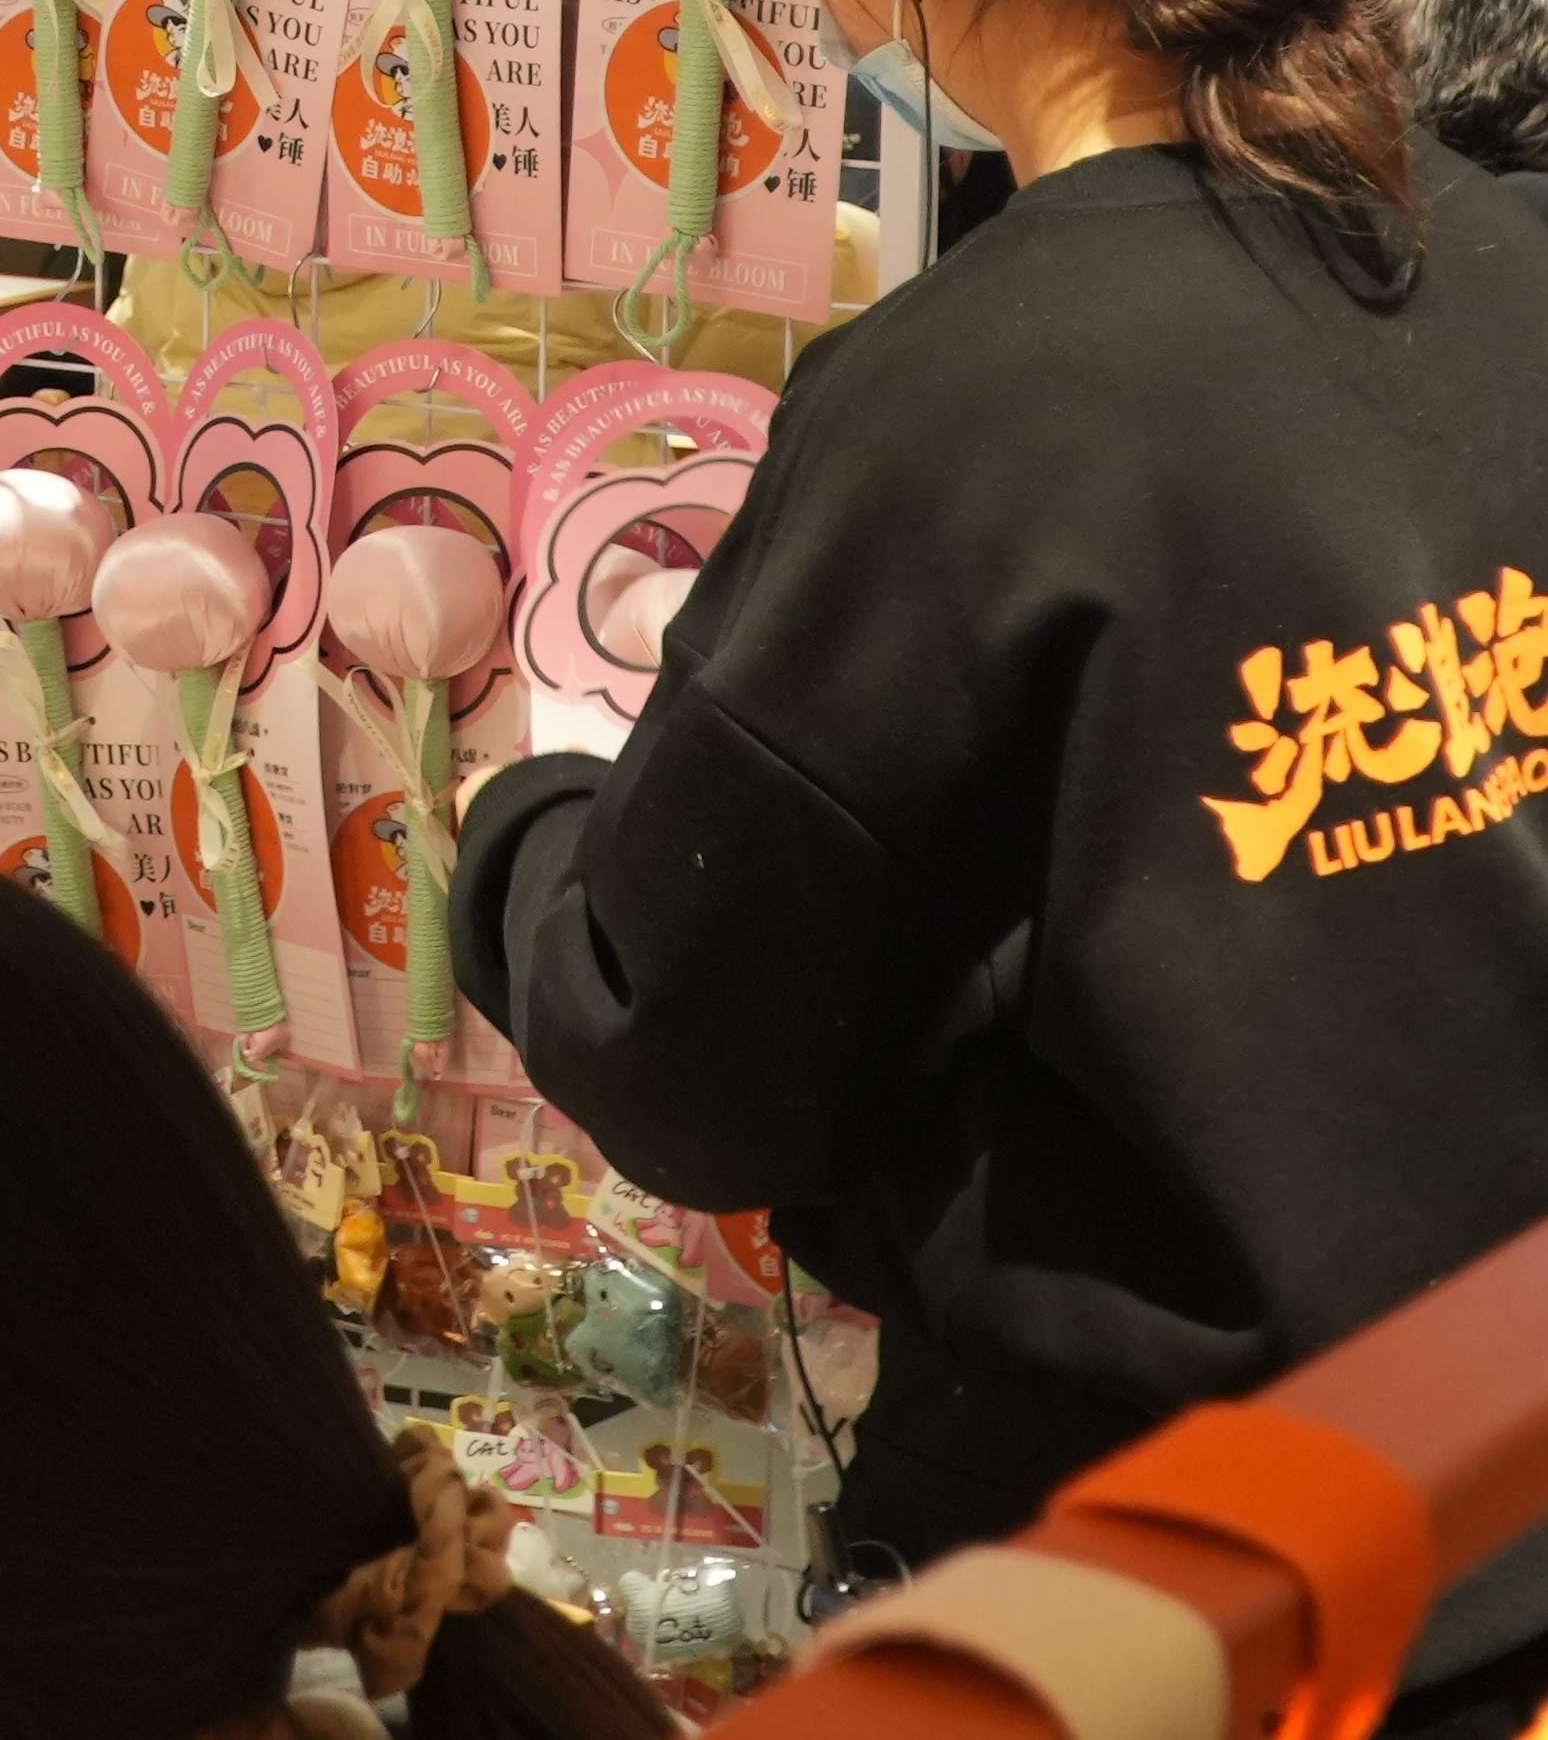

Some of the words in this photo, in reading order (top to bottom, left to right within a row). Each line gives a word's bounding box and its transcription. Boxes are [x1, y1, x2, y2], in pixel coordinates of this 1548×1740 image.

[267, 11, 324, 48] YOU
[485, 20, 541, 50] YOU
[266, 47, 320, 84] ARE
[777, 38, 827, 72] OU
[486, 58, 544, 88] ARE
[792, 80, 829, 111] RE
[121, 176, 143, 200] IN
[216, 206, 273, 244] LOOM
[365, 225, 387, 248] IN
[611, 240, 634, 264] IN
[69, 325, 92, 343] AS
[92, 331, 127, 363] YOU
[123, 363, 152, 398] ARE
[190, 378, 207, 400] AS
[202, 331, 274, 381] BEAUTIFUL
[276, 333, 294, 356] AS
[291, 348, 316, 383] YOU
[308, 383, 327, 419] ARE
[438, 357, 462, 377] AS
[462, 366, 503, 399] YOU
[497, 398, 529, 437] ARE
[564, 386, 675, 462] BEAUTIFUL
[677, 386, 704, 406] AS
[533, 436, 552, 458] AS
[118, 778, 163, 802] YO
[126, 813, 165, 836] AR
